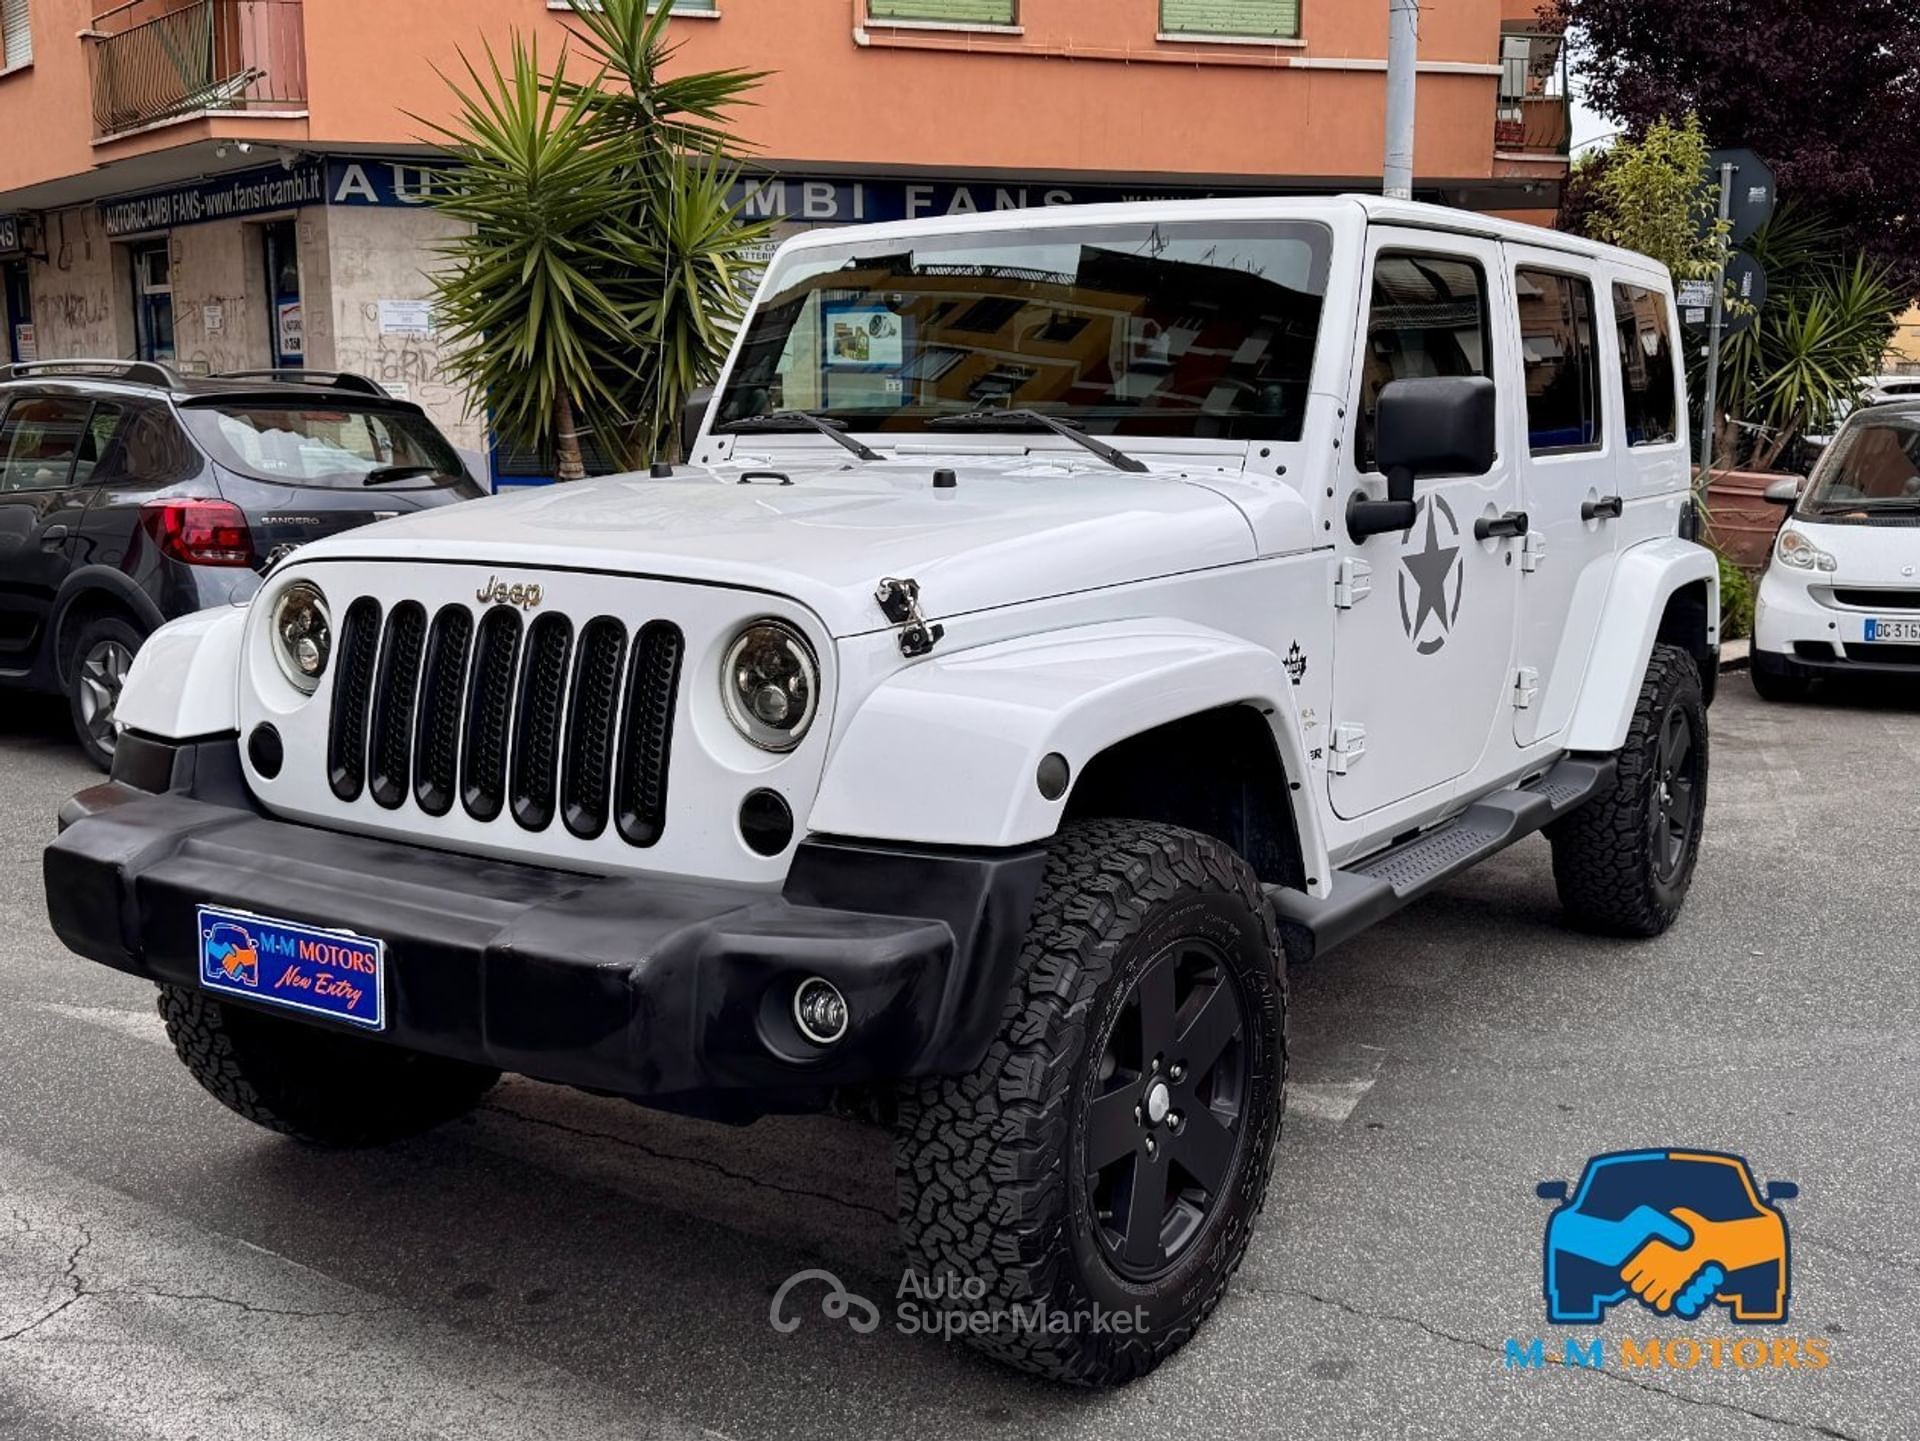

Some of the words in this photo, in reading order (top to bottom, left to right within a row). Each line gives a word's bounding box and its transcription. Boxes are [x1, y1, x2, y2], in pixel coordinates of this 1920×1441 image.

[106, 200, 171, 233] AUTORICAMBI
[173, 190, 201, 222] FANS
[205, 172, 320, 215] www.fansricambi.it
[261, 517, 320, 525] SANDERO
[476, 575, 544, 611] Jeep
[259, 932, 296, 957] M-M
[300, 940, 376, 974] MOTORS
[274, 964, 312, 988] New
[313, 972, 362, 1009] Entry
